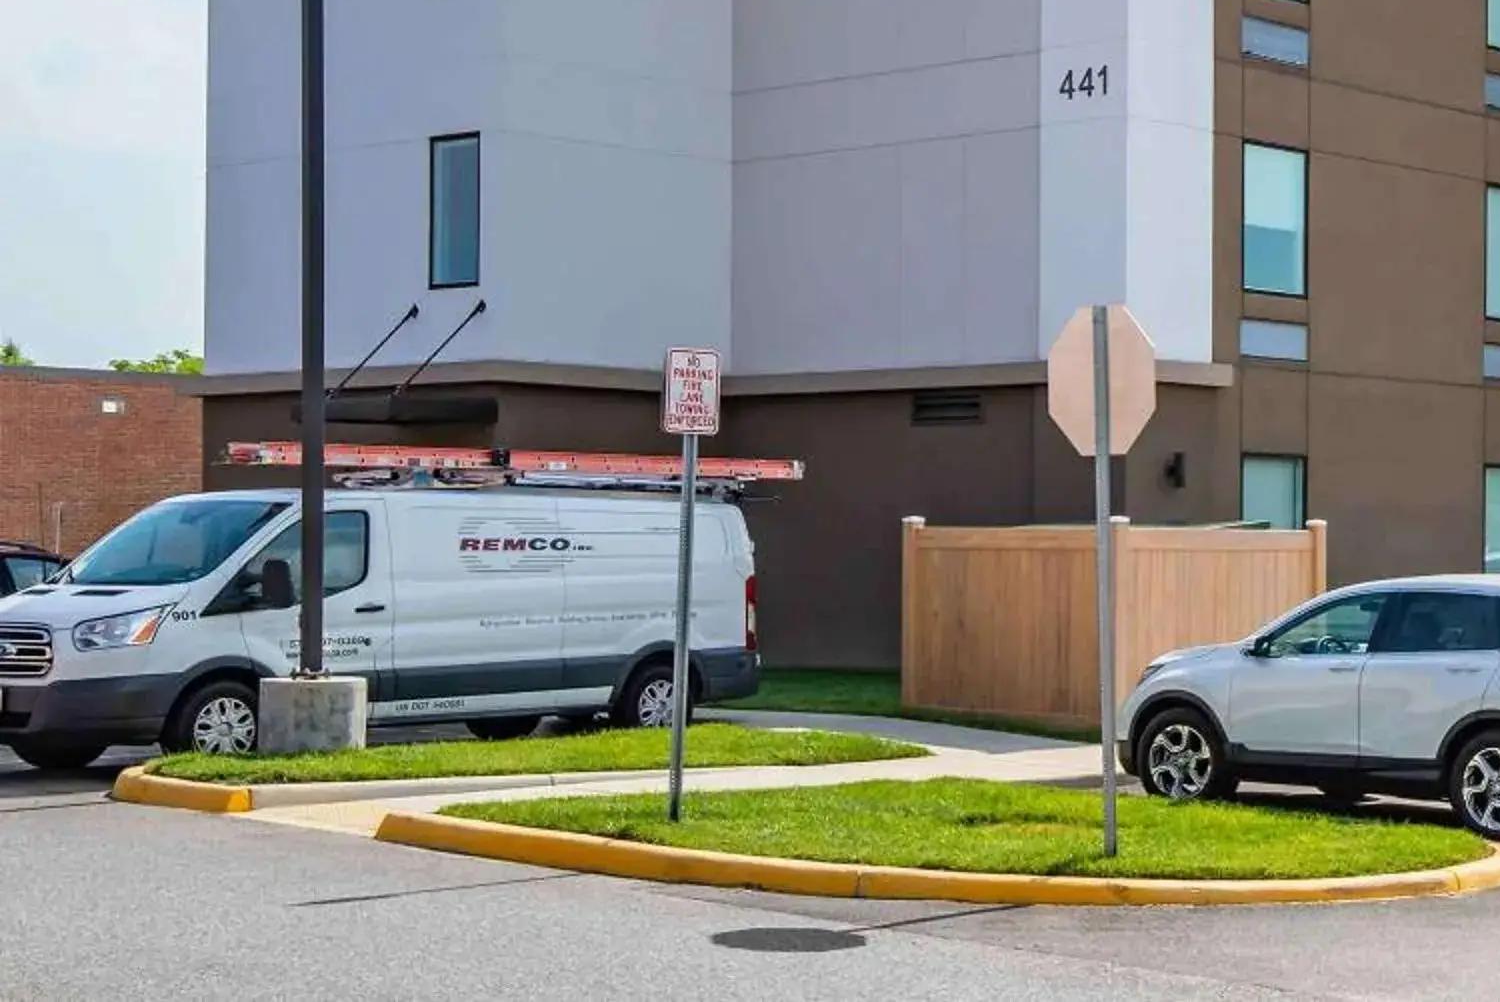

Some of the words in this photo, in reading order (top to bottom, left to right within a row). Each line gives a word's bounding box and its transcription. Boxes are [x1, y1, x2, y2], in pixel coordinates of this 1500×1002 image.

[1059, 64, 1107, 100] 441
[687, 356, 701, 368] NO
[674, 368, 714, 381] PARKING
[675, 401, 713, 415] TOWING
[459, 538, 570, 551] REMCO
[172, 610, 196, 622] 901
